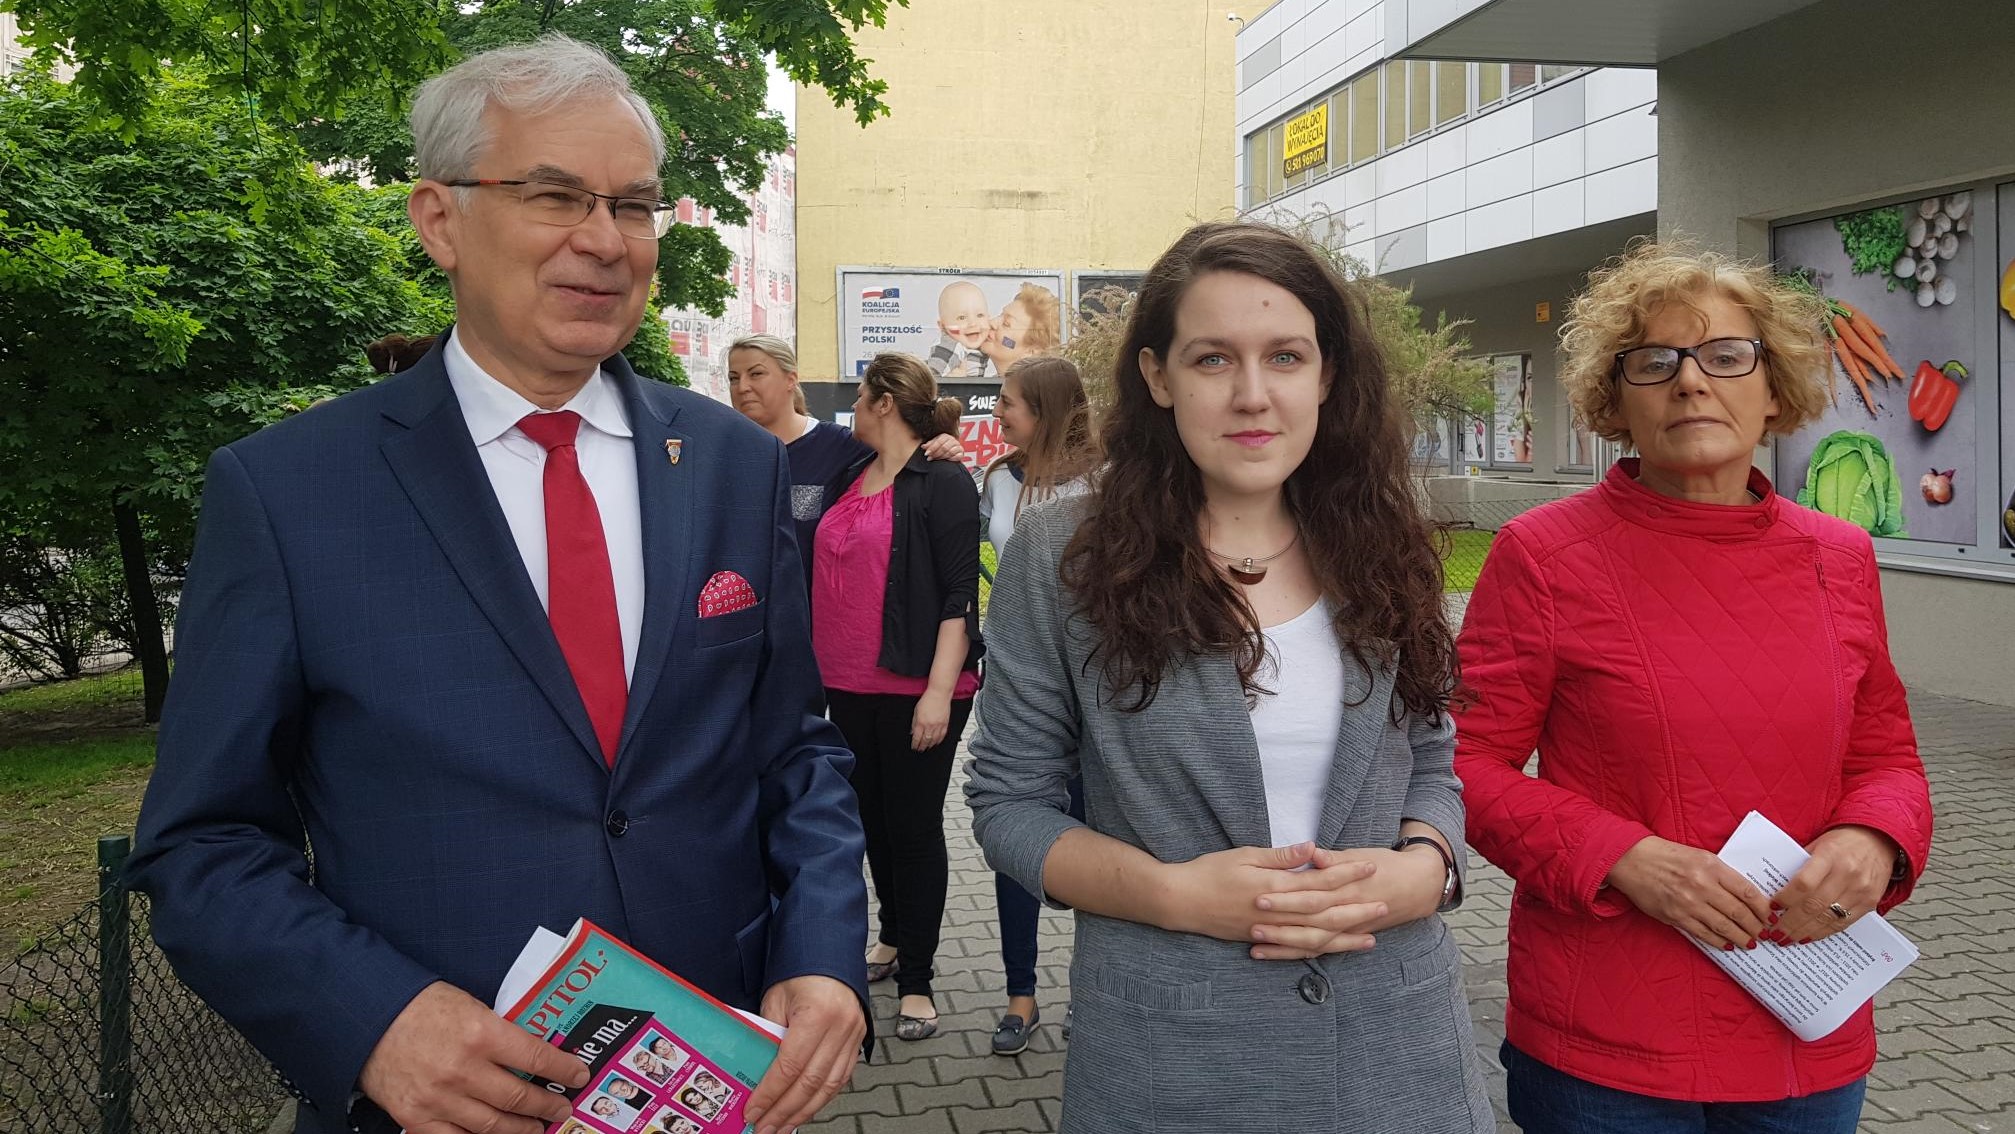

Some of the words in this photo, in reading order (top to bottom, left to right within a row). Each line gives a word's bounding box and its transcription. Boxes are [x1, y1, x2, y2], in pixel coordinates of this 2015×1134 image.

[1289, 117, 1310, 137] LOKAL
[1310, 112, 1321, 127] DO
[1287, 124, 1324, 154] WYNAJĘCIA
[862, 324, 922, 334] PRZYSZŁOŚĆ
[862, 335, 896, 344] POLSKI
